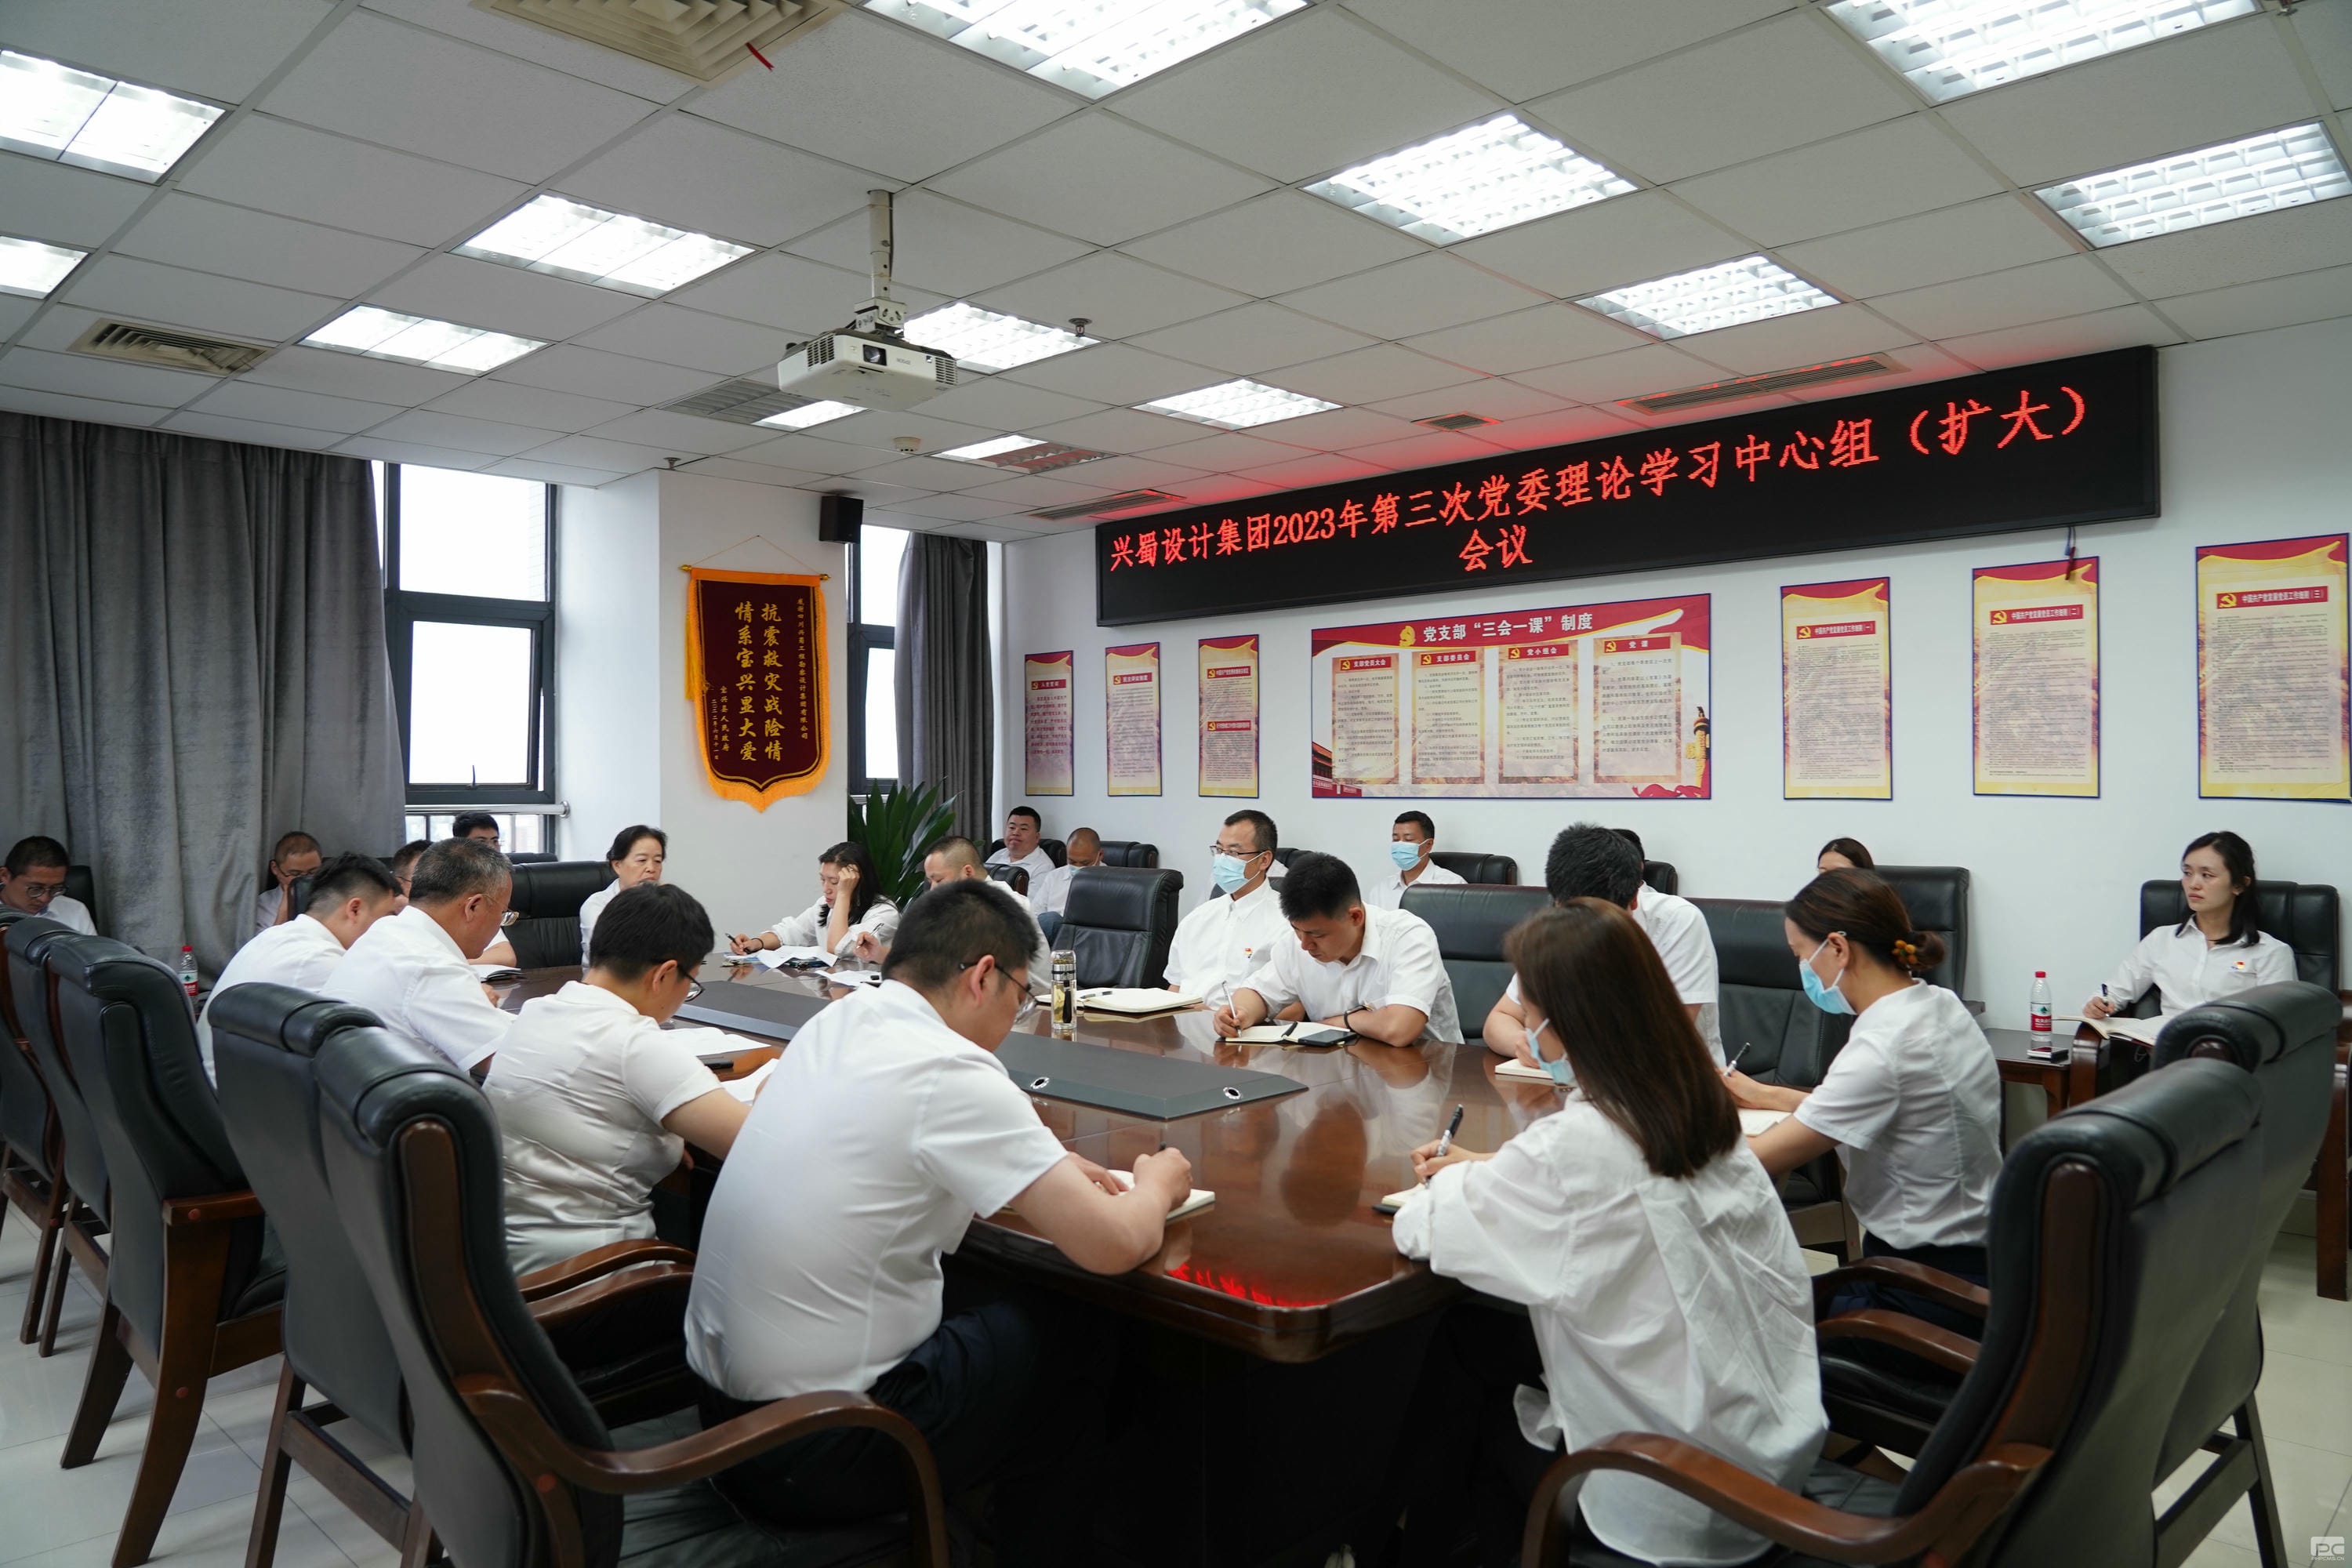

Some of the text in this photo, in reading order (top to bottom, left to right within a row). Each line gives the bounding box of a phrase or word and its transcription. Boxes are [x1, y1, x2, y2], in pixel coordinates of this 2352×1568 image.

[1458, 524, 1533, 572] 会议
[1526, 646, 1558, 656] 党小组会
[761, 603, 786, 762] 抗震救灾战险情
